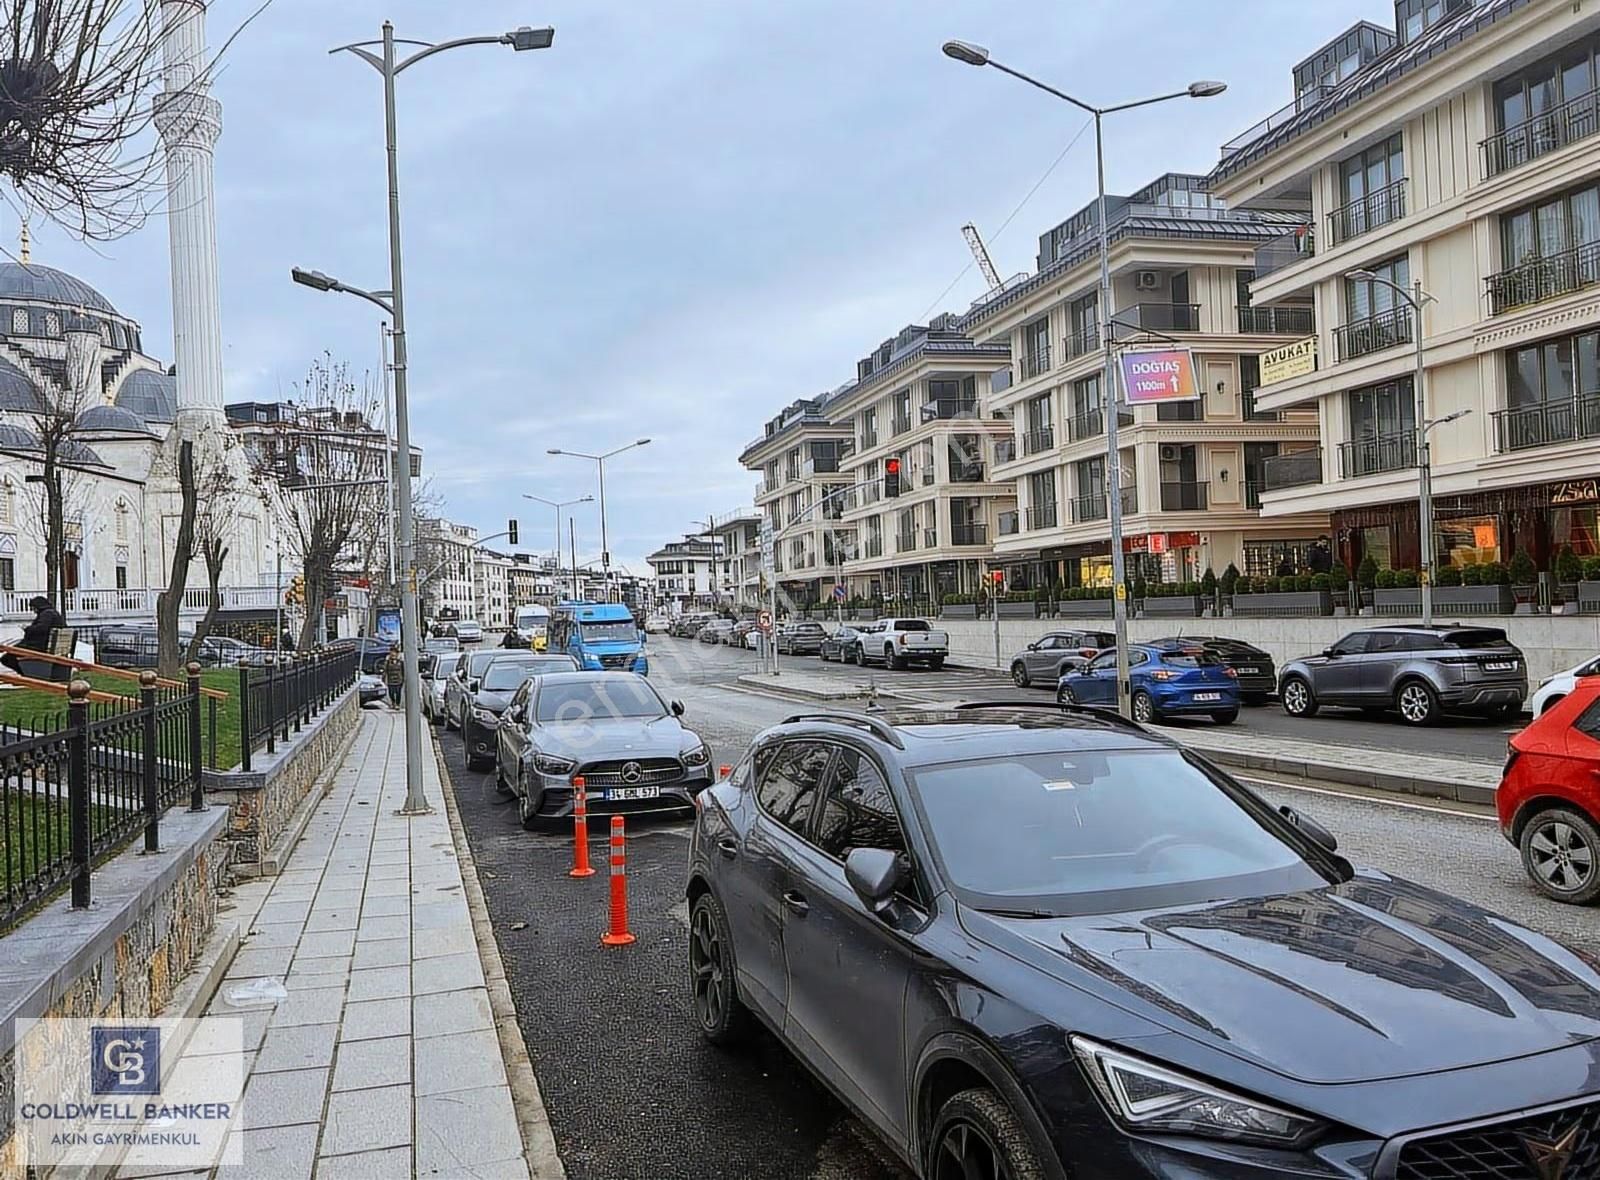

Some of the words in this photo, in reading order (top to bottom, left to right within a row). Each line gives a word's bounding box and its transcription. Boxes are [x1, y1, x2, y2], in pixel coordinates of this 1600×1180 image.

[1264, 341, 1311, 366] AVUKAT
[1136, 381, 1166, 392] 1100m
[1154, 537, 1163, 549] E
